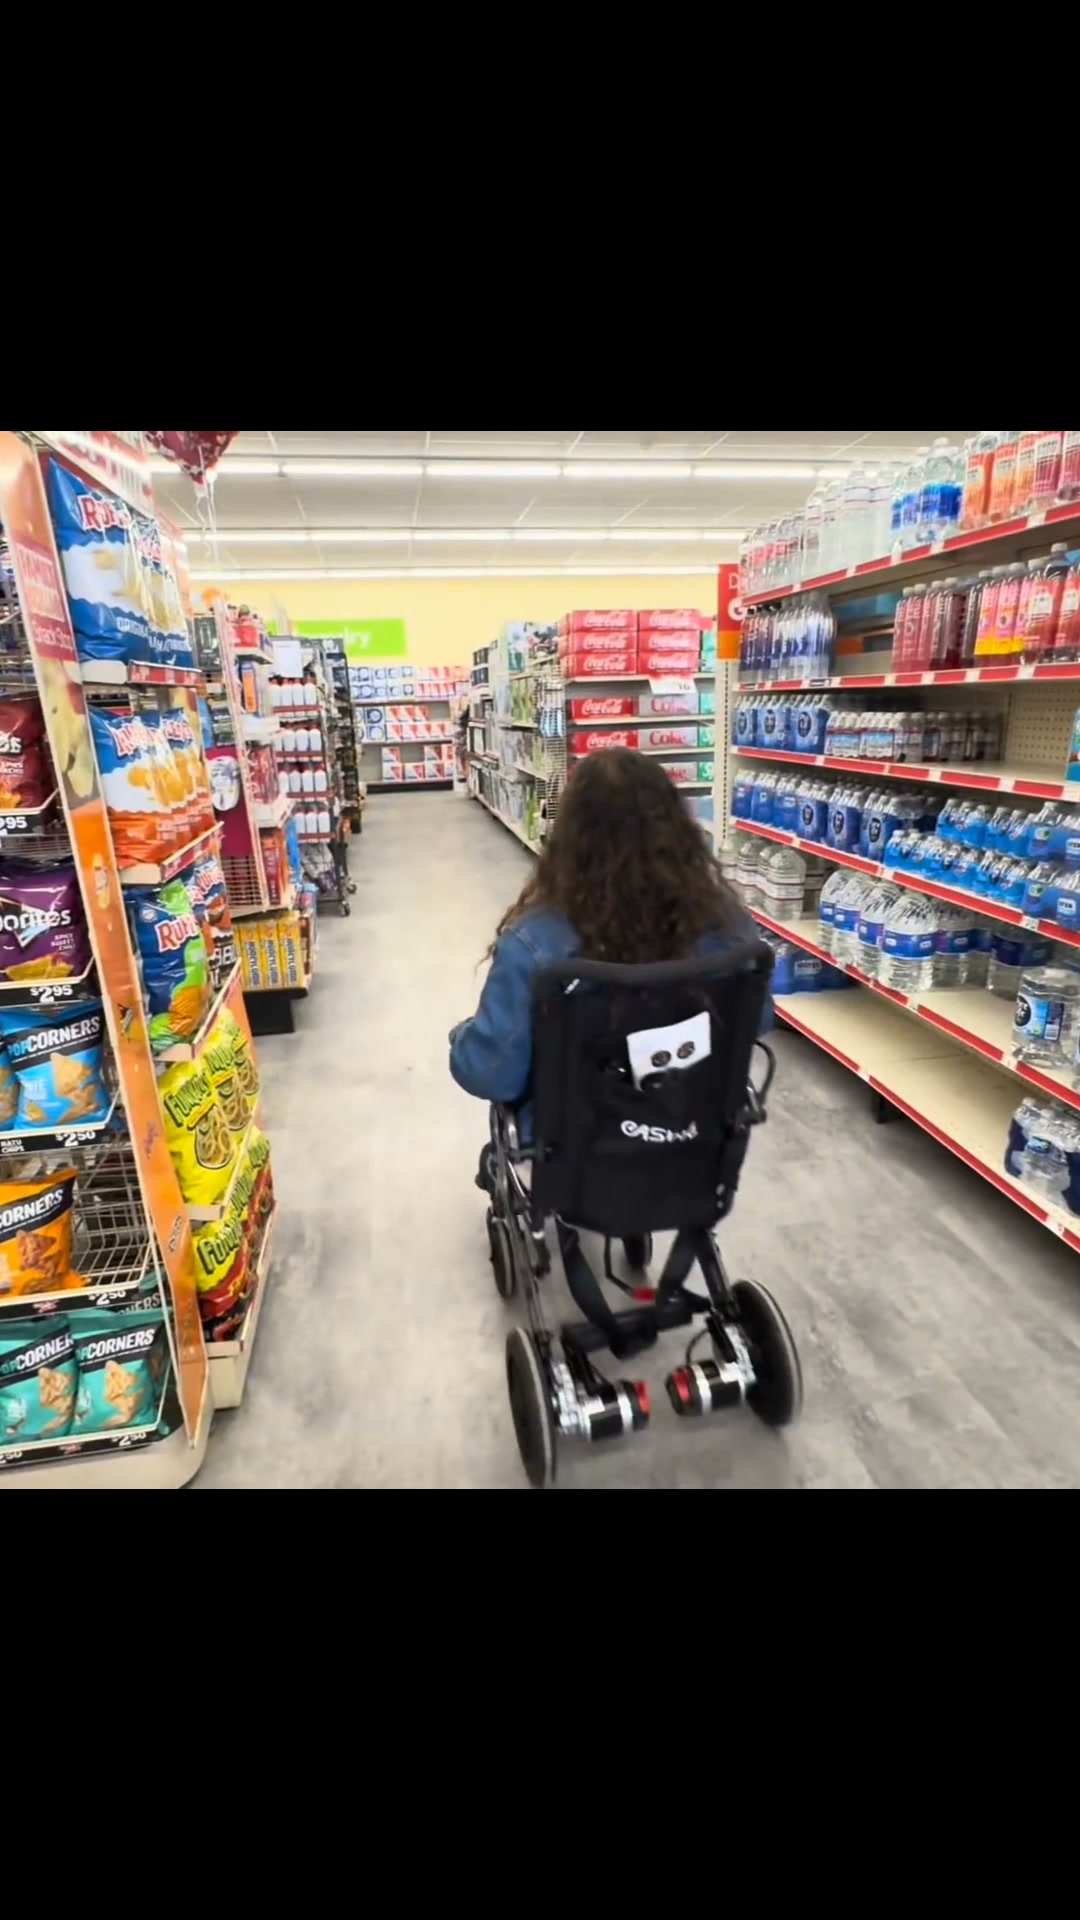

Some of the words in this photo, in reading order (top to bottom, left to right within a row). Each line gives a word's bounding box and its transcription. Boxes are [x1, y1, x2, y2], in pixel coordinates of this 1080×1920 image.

[583, 652, 628, 671] Coca-Cola
[581, 698, 623, 715] Coca-Cola
[586, 731, 628, 748] Coca-Cola
[0, 909, 71, 932] oritos
[0, 1189, 63, 1229] ORNERS
